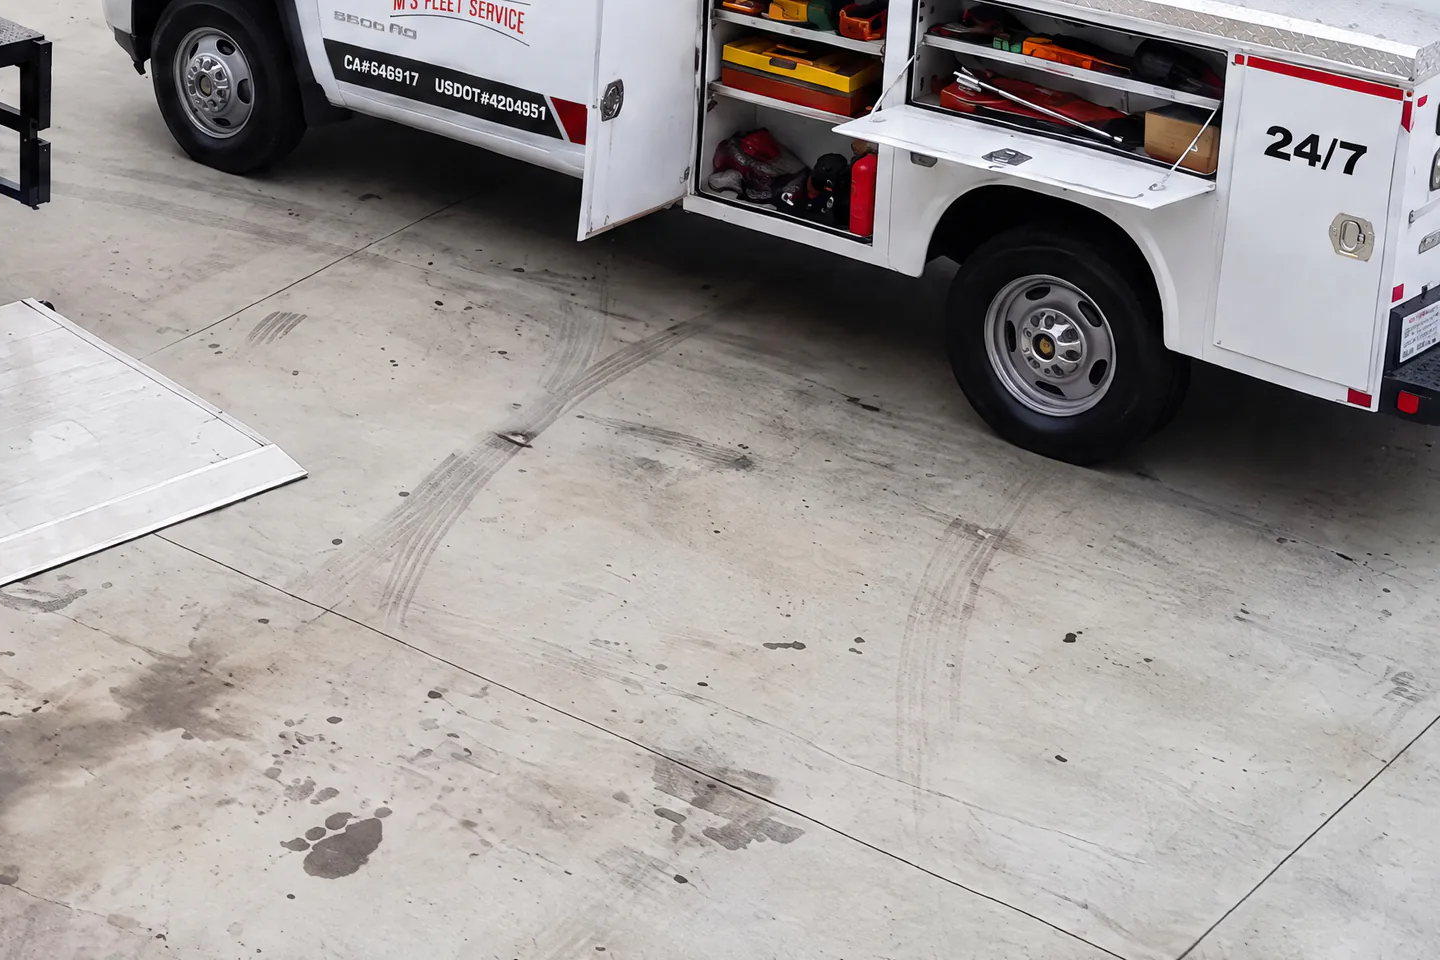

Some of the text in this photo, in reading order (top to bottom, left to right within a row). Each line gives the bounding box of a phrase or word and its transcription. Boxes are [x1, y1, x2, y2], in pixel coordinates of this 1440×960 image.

[469, 0, 525, 35] SERVICE
[343, 54, 547, 121] CA#646917 USDOT#4204951
[1263, 126, 1368, 176] 24/7
